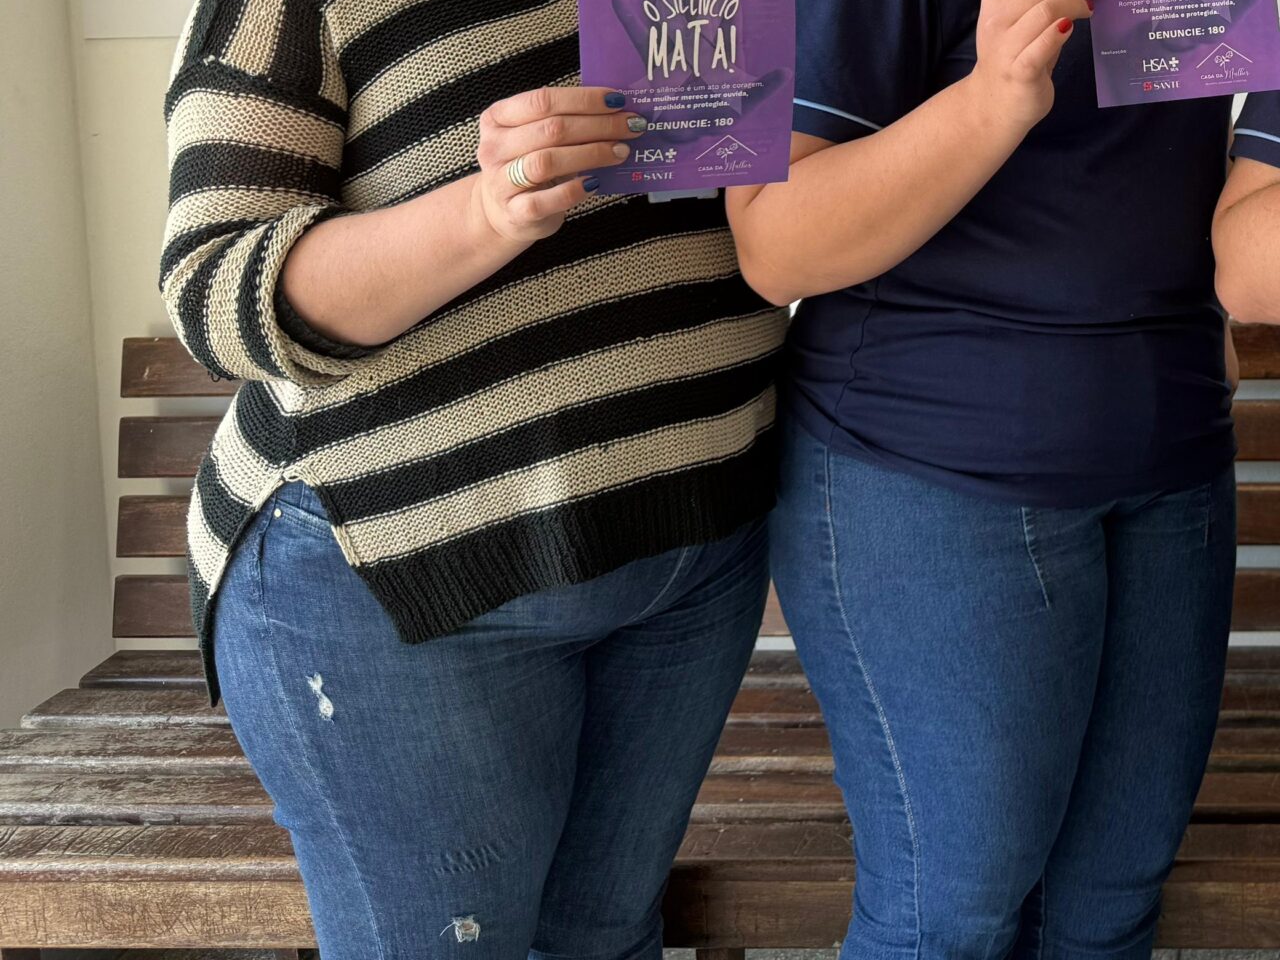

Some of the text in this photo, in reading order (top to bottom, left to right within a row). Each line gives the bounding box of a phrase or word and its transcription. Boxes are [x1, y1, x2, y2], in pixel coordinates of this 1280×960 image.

[644, 0, 660, 22] O
[1212, 0, 1235, 7] ouvida,
[1151, 12, 1180, 20] acolhida
[1186, 9, 1220, 18] protegida.
[1148, 25, 1225, 40] DENUNCIE: 180
[648, 19, 736, 80] MATA!
[1142, 57, 1168, 72] HSA
[653, 102, 685, 110] acolhida
[693, 100, 730, 108] protegida.
[647, 117, 734, 129] DENUNCIE: 180
[635, 148, 664, 163] HSA
